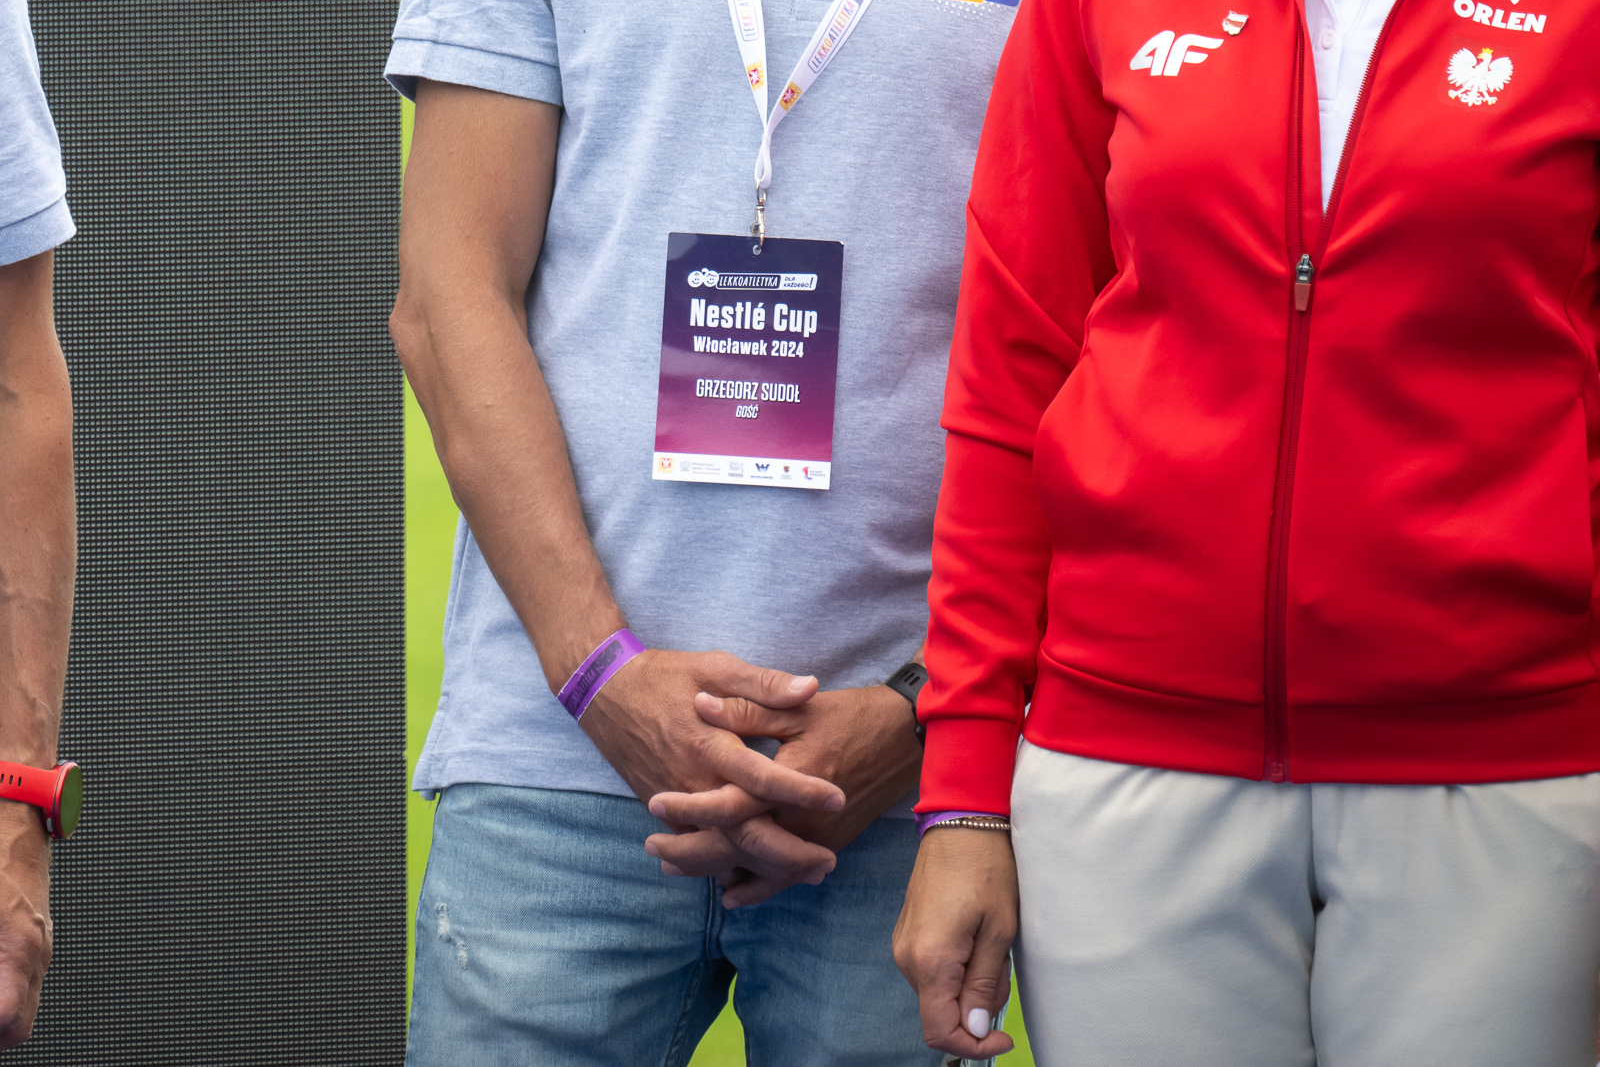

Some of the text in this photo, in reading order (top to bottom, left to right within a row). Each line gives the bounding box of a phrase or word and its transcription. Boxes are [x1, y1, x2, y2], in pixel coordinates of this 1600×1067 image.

[812, 0, 855, 68] LEKKOATLETYKA
[720, 275, 778, 287] LEKKOATLETYKA
[689, 298, 818, 338] Nestlé Cup
[693, 335, 804, 358] Włocławek 2024
[696, 378, 801, 403] GRZEGORZ SUDOŁ
[736, 404, 759, 419] GOŚĆ
